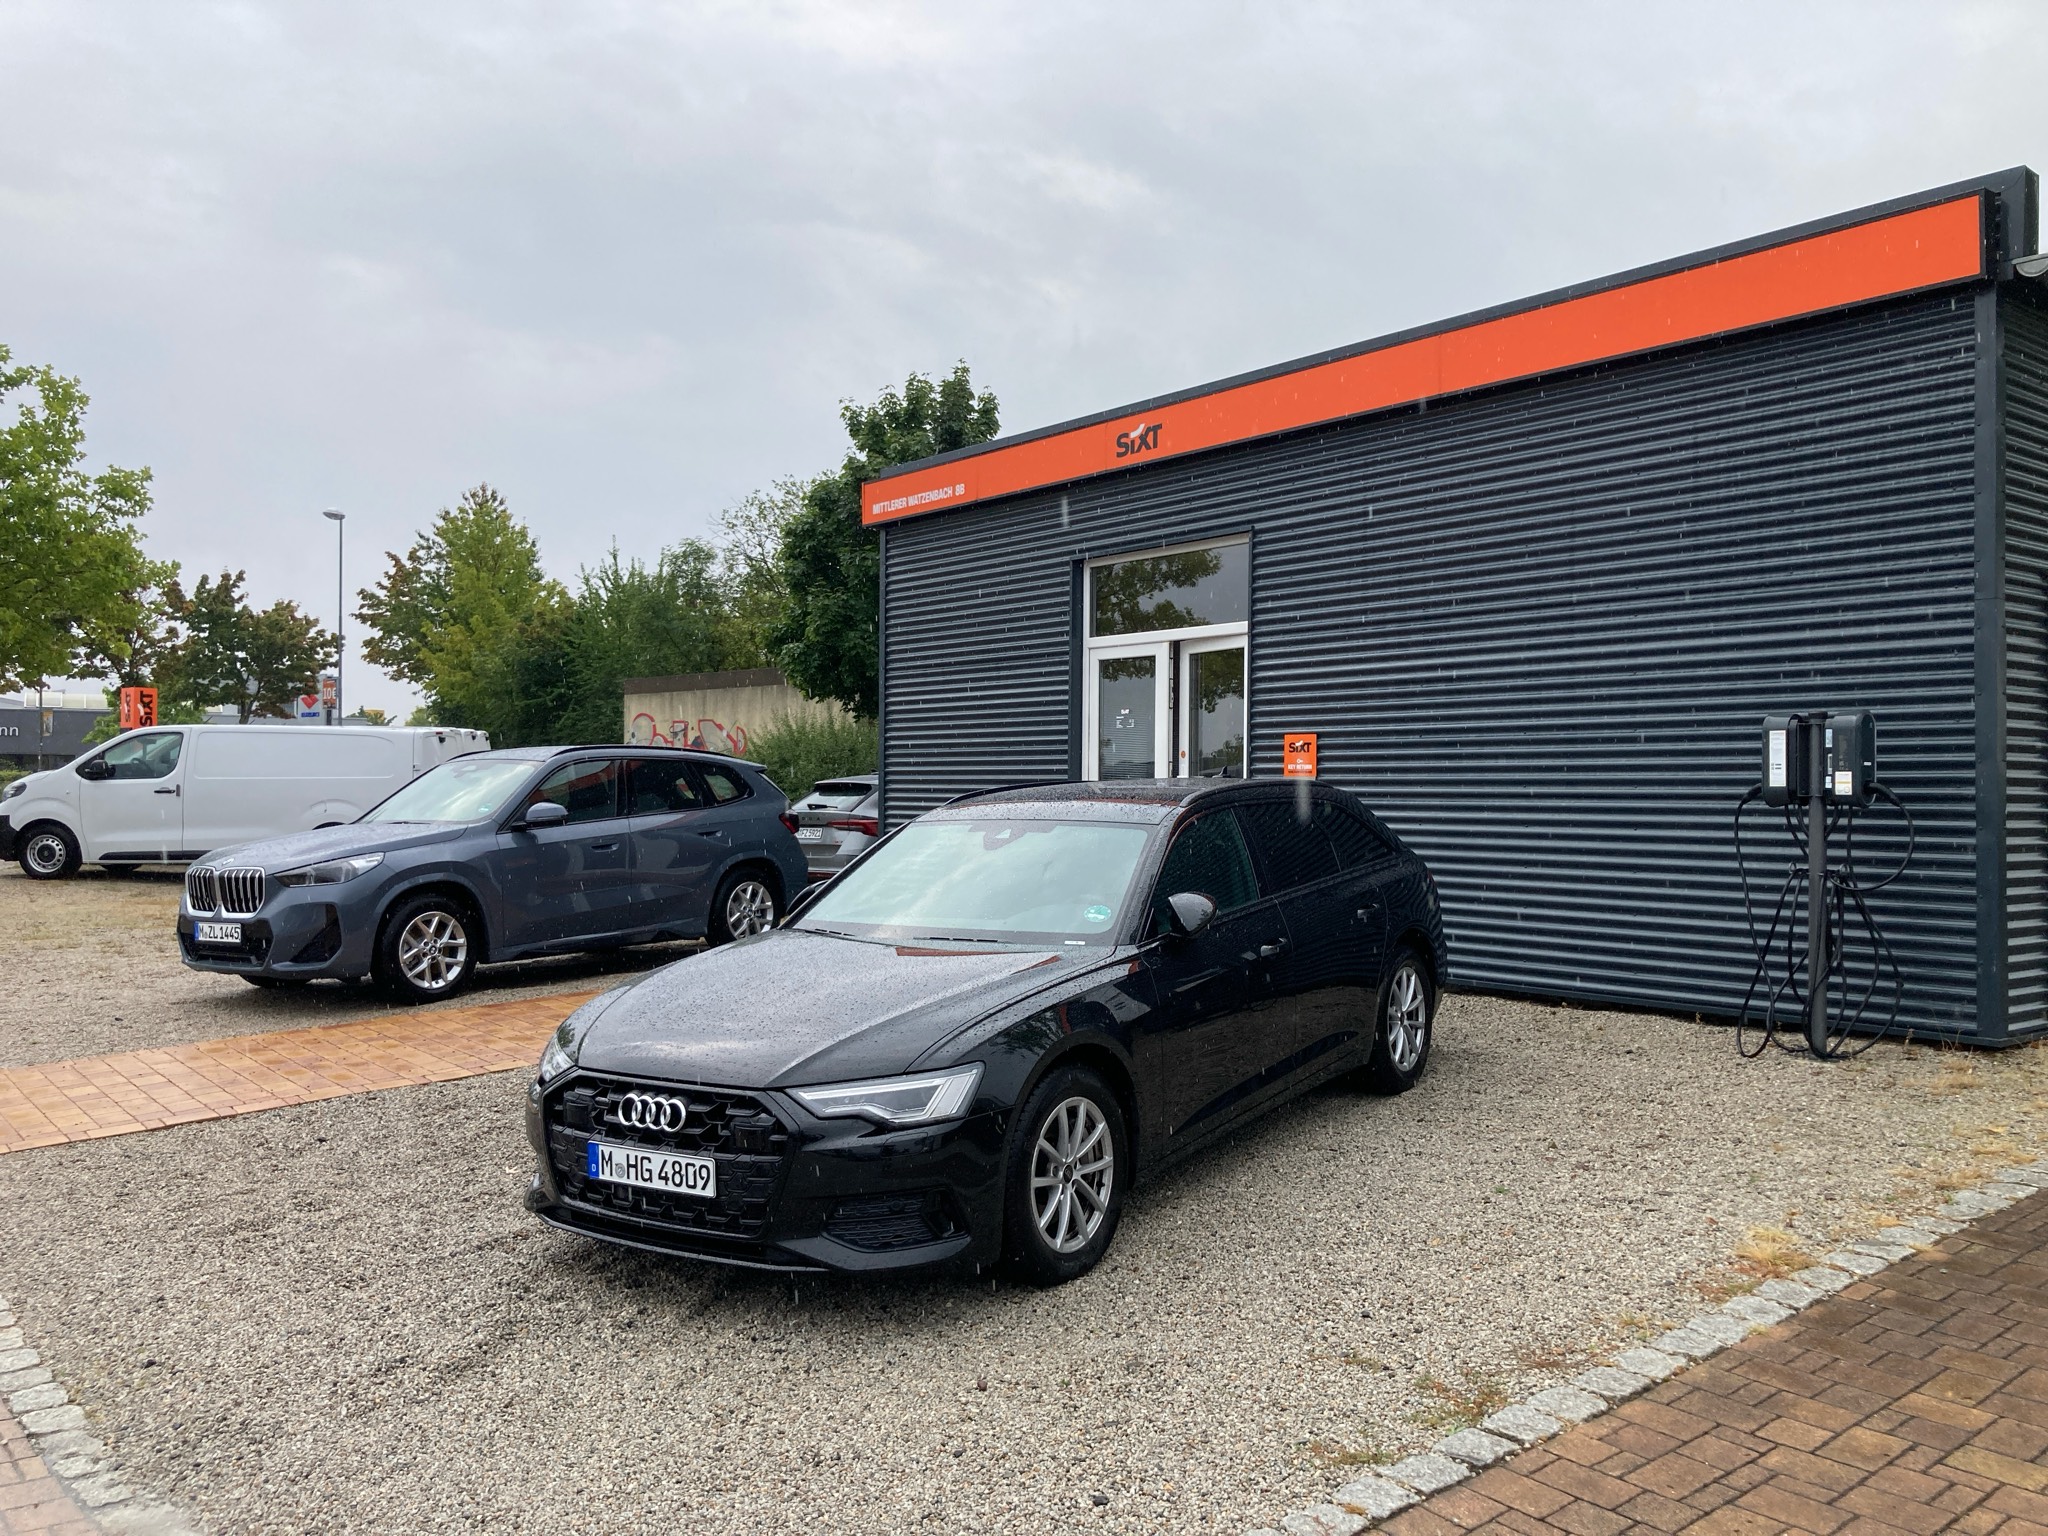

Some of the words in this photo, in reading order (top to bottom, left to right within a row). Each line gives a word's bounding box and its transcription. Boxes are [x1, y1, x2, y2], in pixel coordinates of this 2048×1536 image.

[872, 496, 907, 515] MITTLERER
[907, 486, 953, 507] WATZENBACH
[219, 926, 241, 940] 1445
[601, 1149, 613, 1177] M
[626, 1153, 653, 1183] HG
[658, 1159, 711, 1191] 4809
